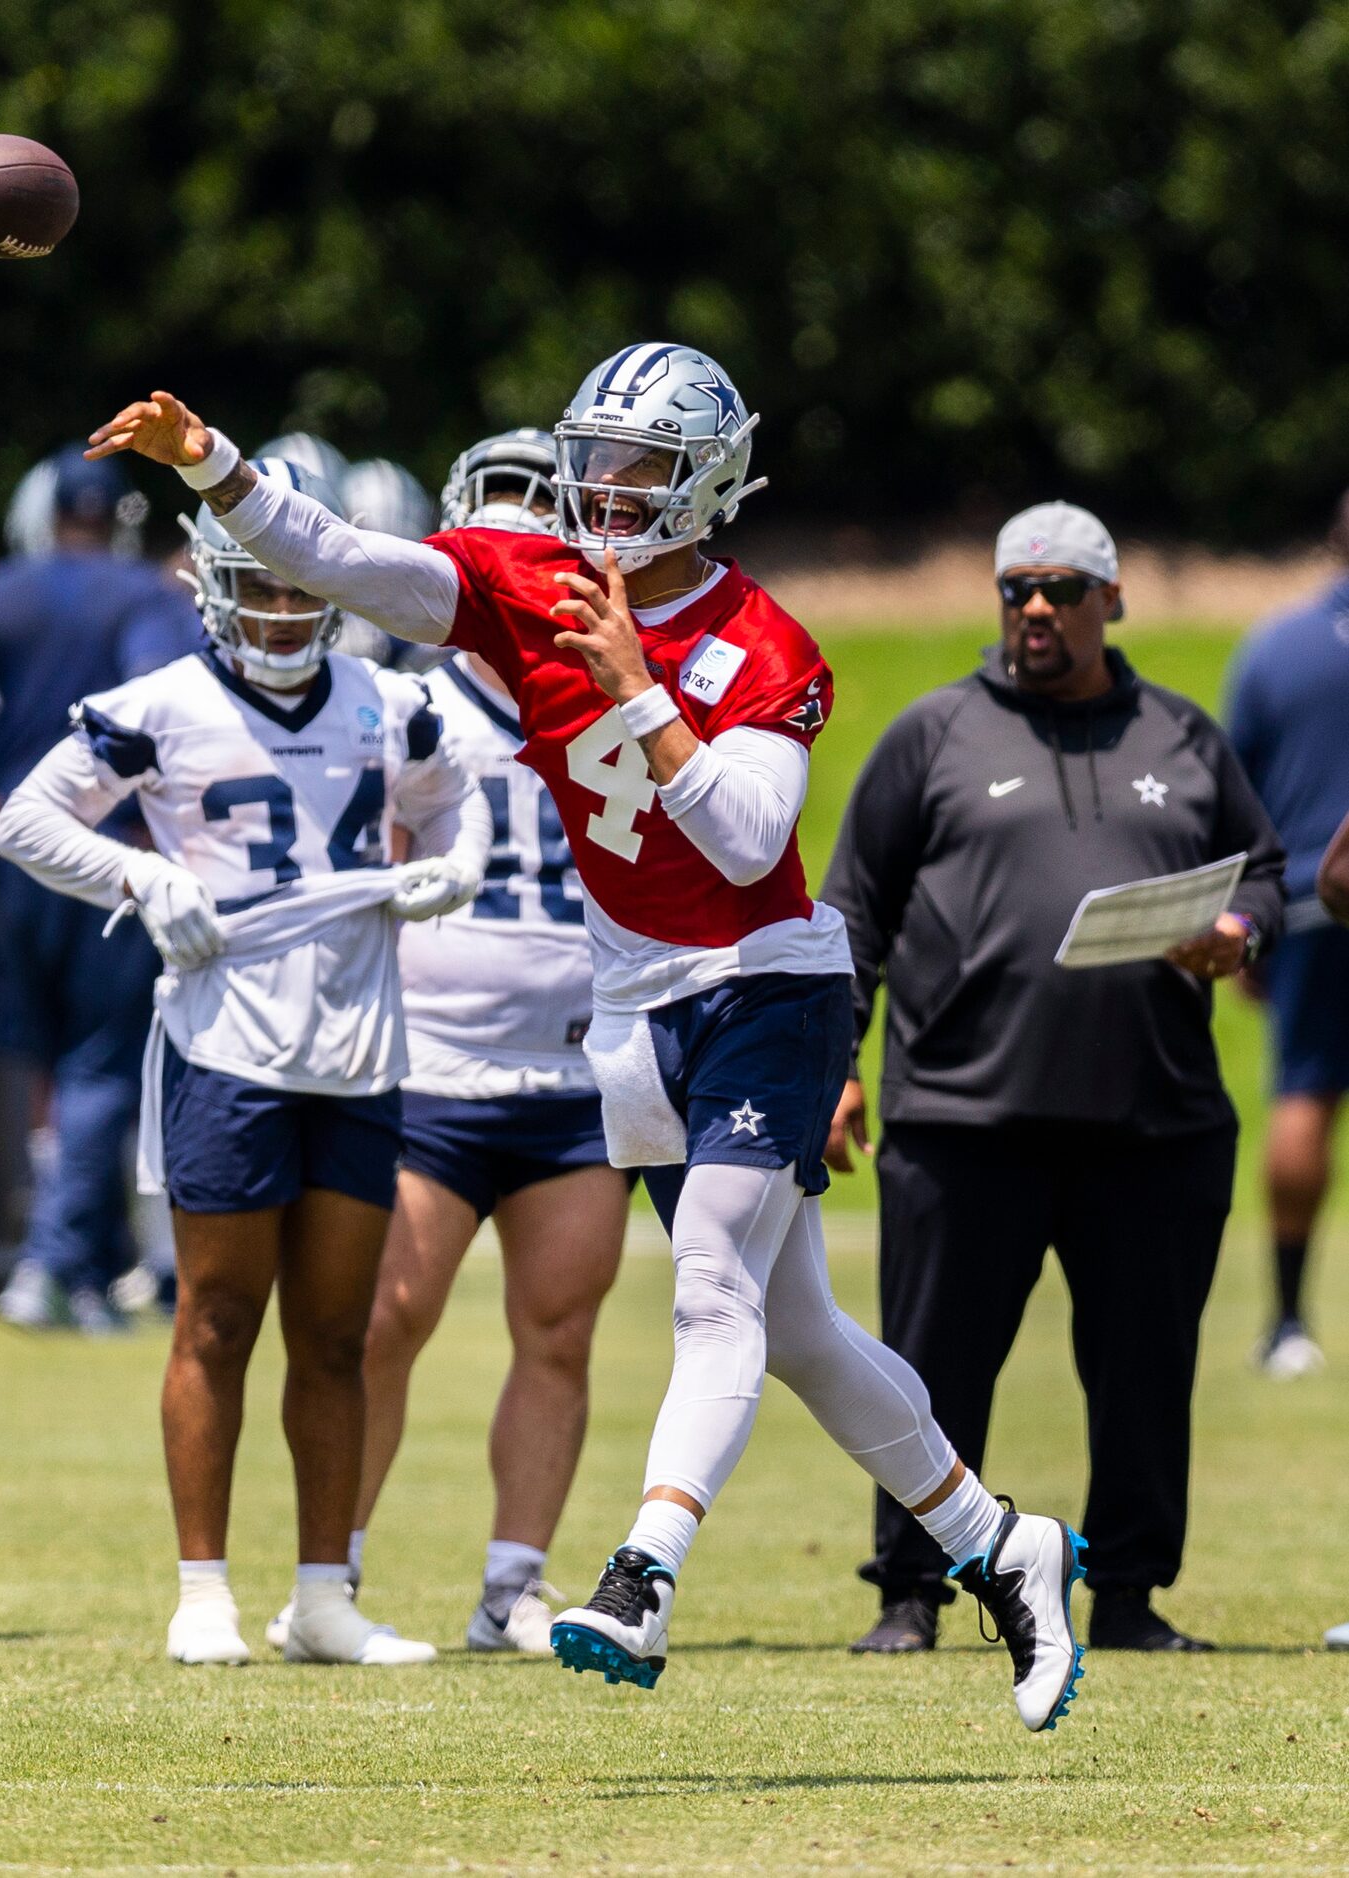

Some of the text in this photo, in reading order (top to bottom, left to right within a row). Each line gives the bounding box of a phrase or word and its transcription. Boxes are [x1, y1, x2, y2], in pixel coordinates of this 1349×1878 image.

[681, 670, 715, 692] AT&T
[201, 766, 400, 916] 34
[565, 703, 658, 864] 4
